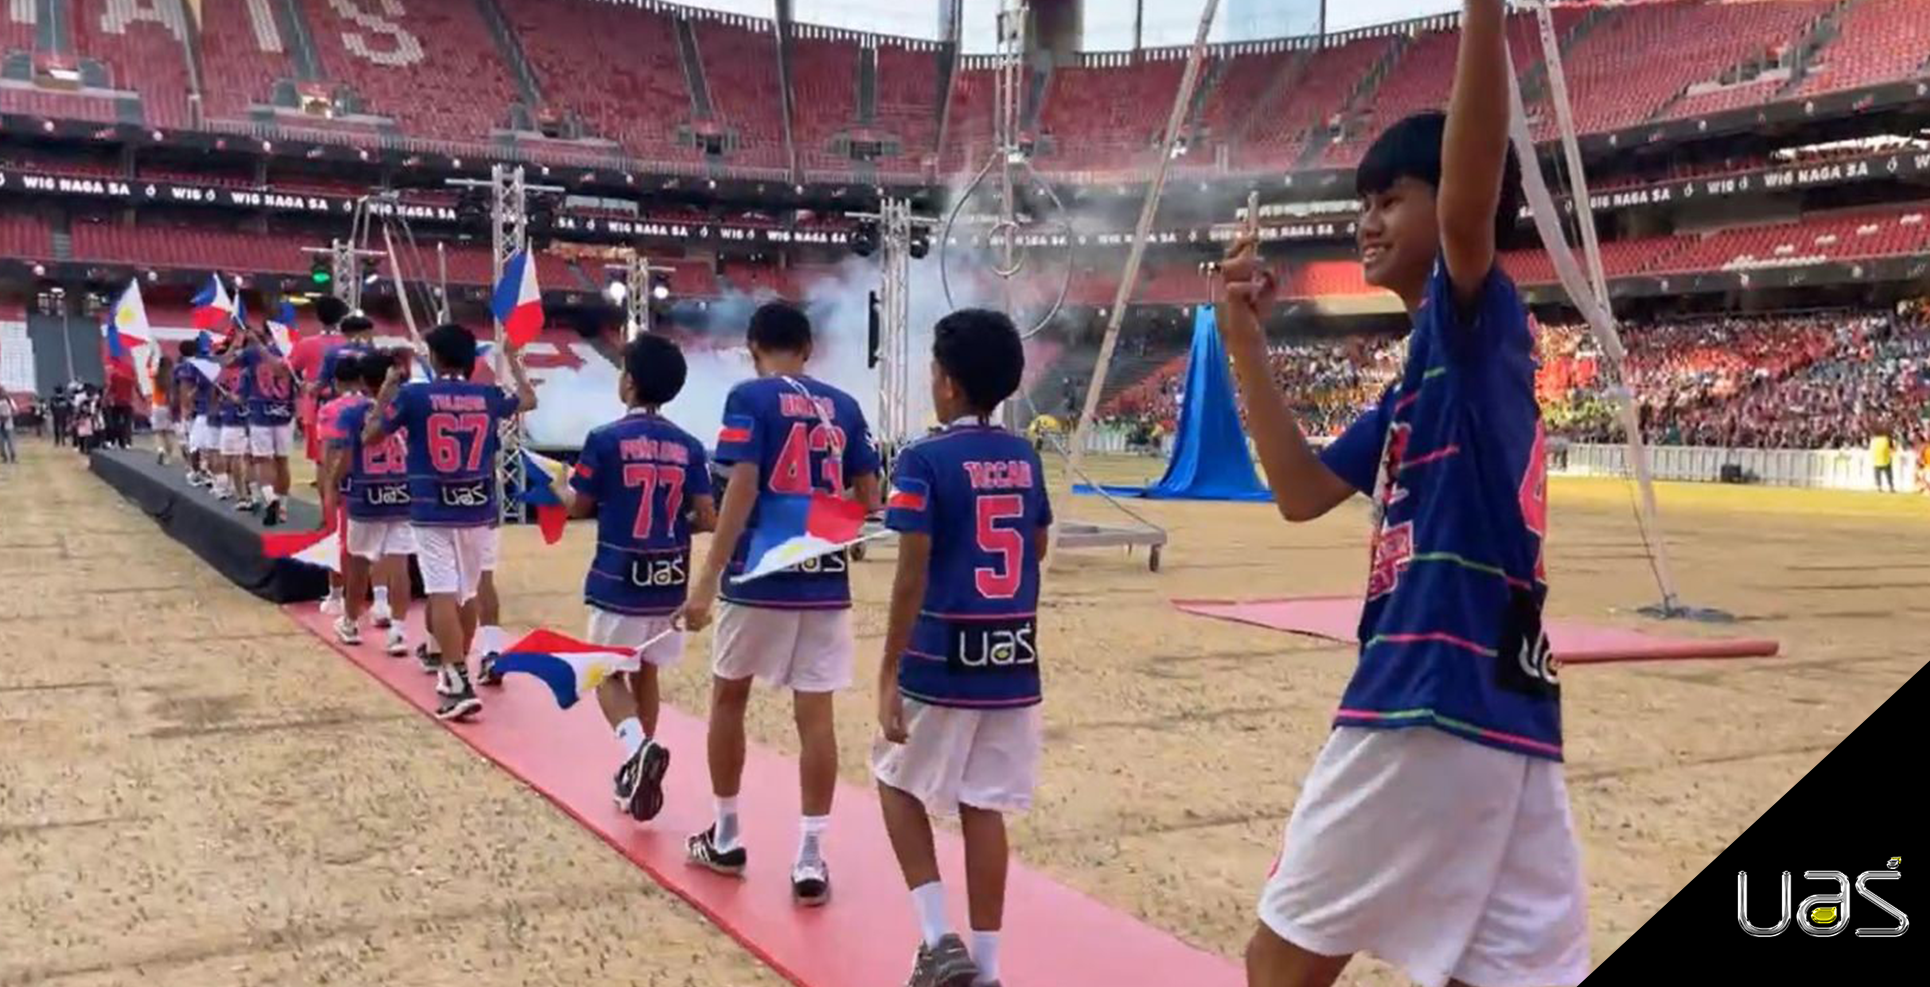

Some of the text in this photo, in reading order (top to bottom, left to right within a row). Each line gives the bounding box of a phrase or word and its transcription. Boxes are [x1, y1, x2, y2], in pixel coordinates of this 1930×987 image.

[1799, 166, 1841, 182] NAGA
[1847, 162, 1868, 177] SA
[59, 179, 104, 194] NAGA
[108, 182, 131, 196] SA
[265, 195, 304, 209] NAGA
[308, 199, 329, 211] SA
[1614, 192, 1648, 206] NAGA
[1652, 188, 1671, 202] SA
[438, 208, 457, 220] SA
[635, 223, 668, 235] NAGA
[671, 226, 689, 237] SA
[795, 231, 828, 243] NAGA
[427, 412, 489, 473] 67
[769, 422, 847, 498] 43
[624, 463, 686, 539] 77
[974, 494, 1024, 599] 5
